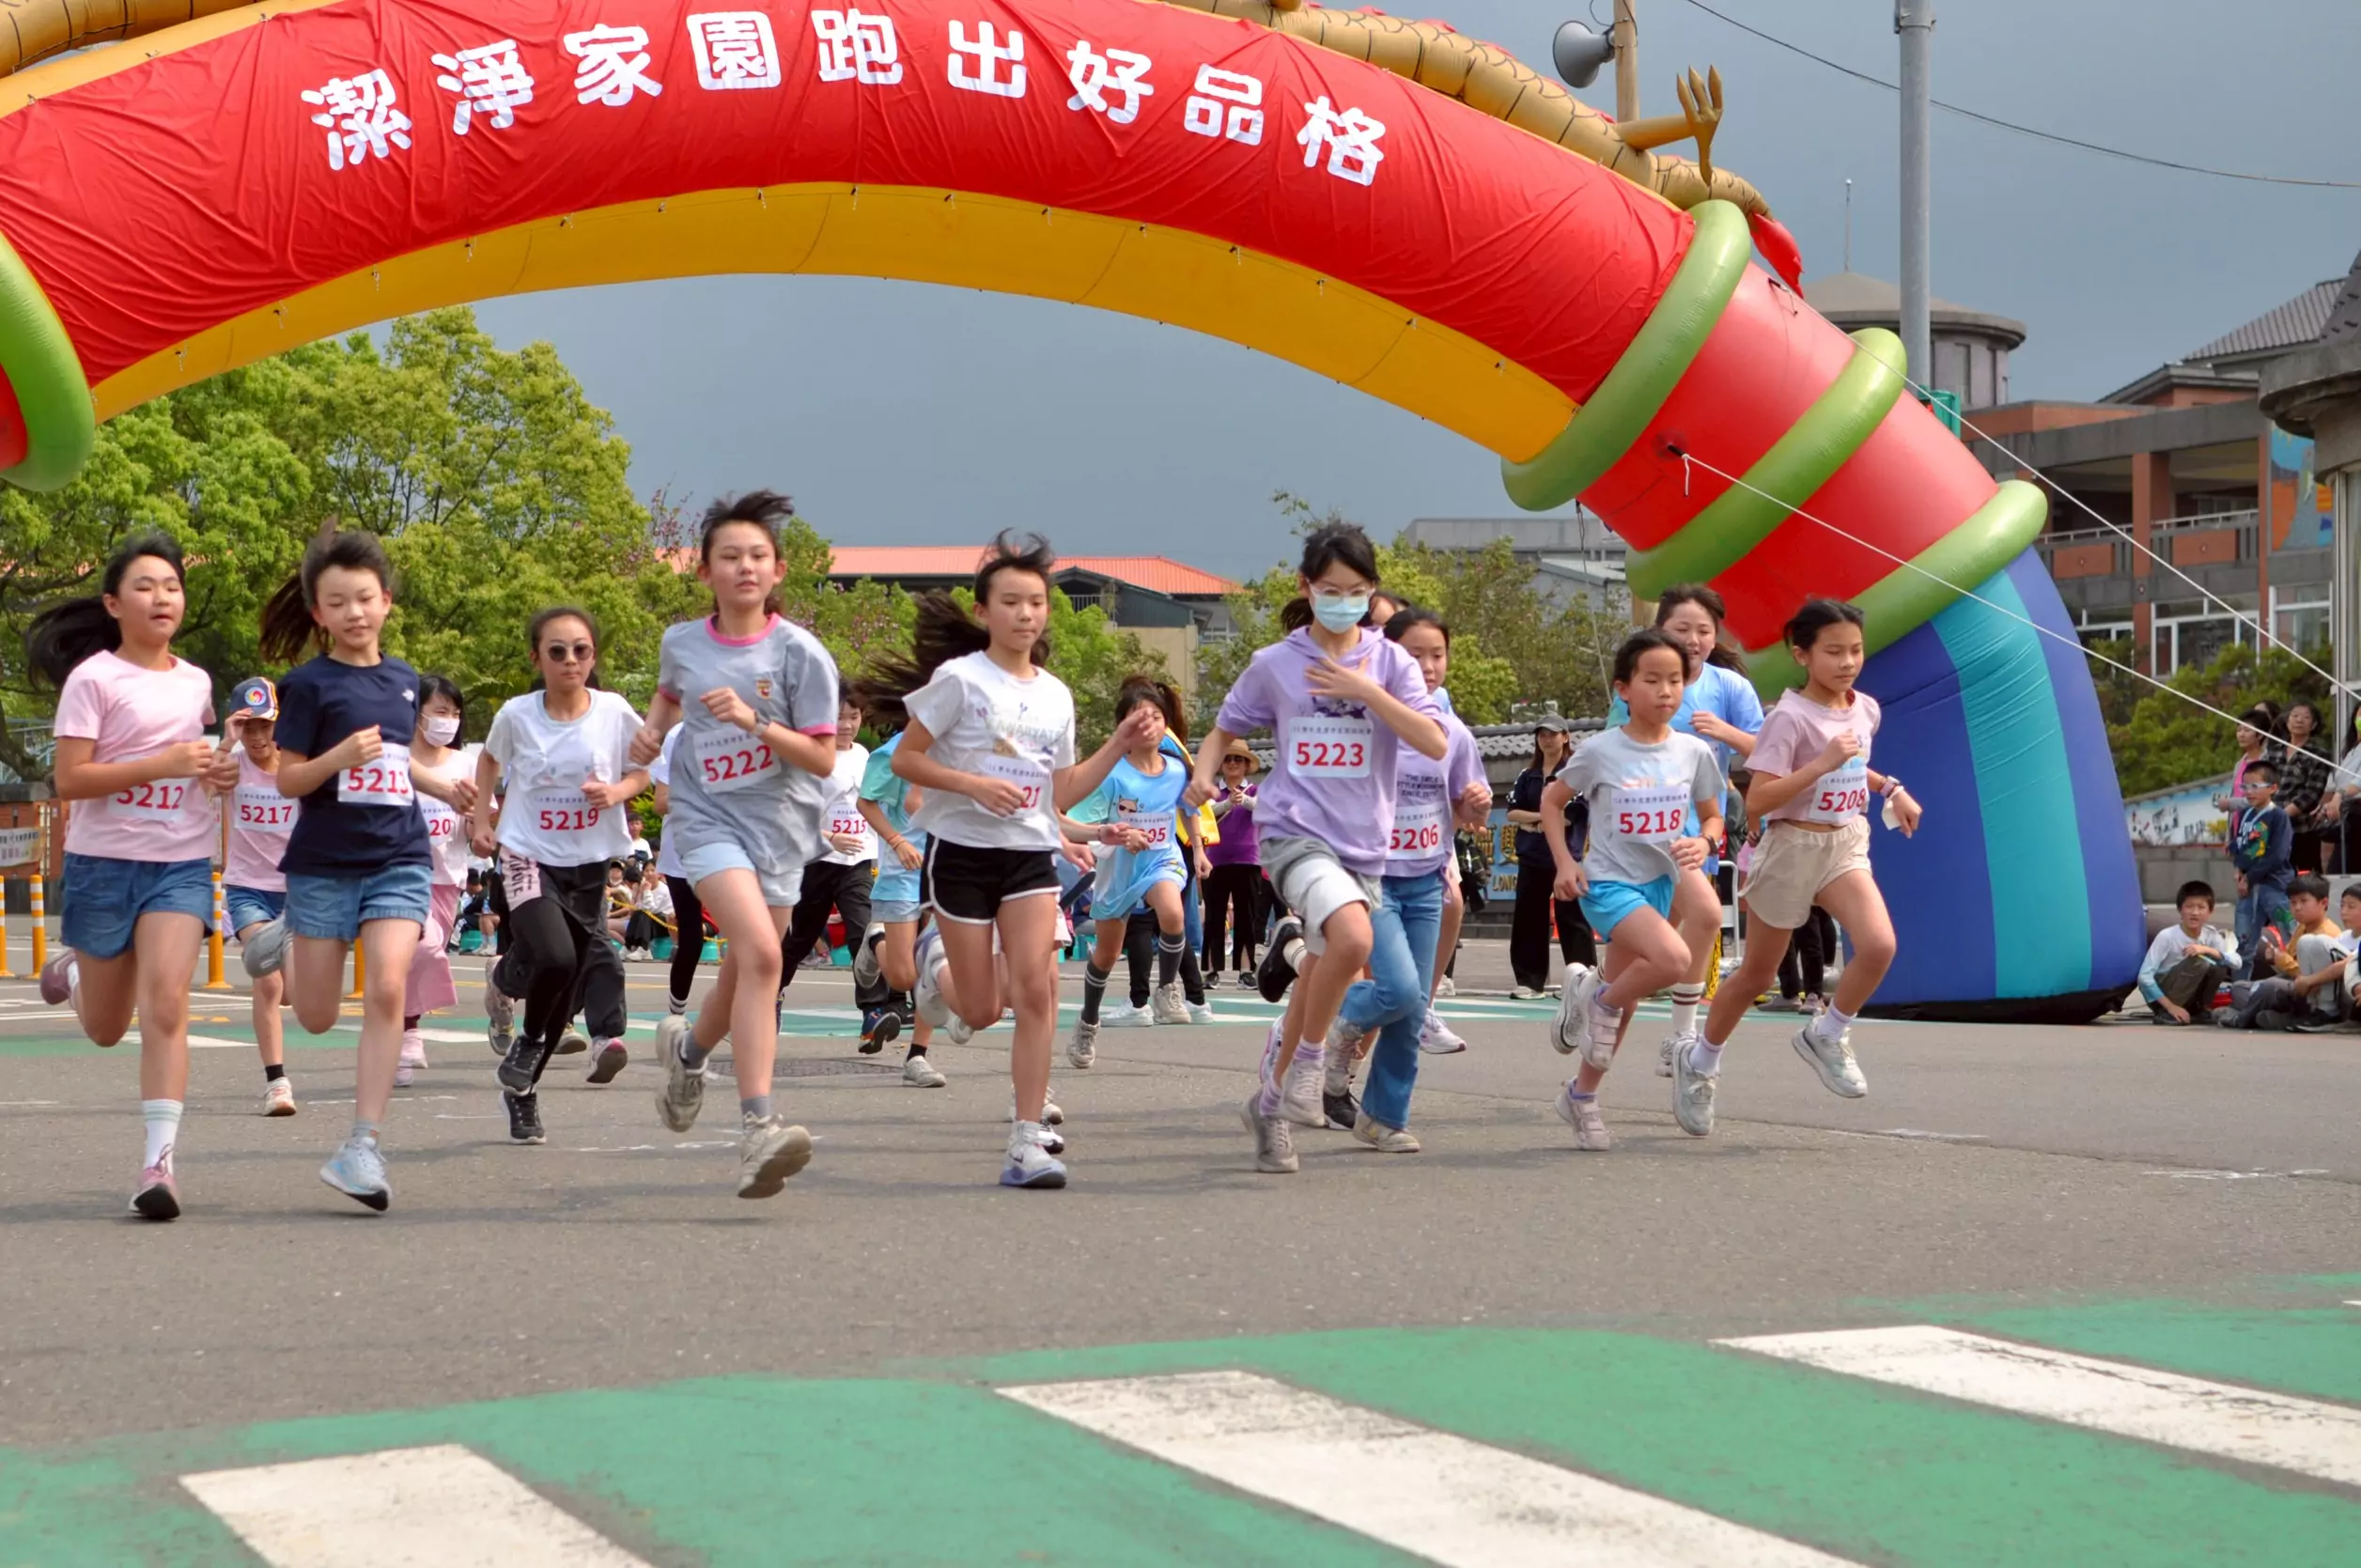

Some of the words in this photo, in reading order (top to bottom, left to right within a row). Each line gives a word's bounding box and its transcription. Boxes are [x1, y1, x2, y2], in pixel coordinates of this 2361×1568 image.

[301, 8, 1386, 186] 潔淨家園跑出好品格
[703, 745, 773, 782] 5222
[1297, 742, 1363, 767] 5223
[1020, 785, 1041, 809] 21
[1818, 787, 1866, 813] 5208
[241, 804, 292, 824] 5217
[539, 807, 599, 831] 5219
[1619, 809, 1681, 834] 5218
[429, 818, 451, 836] 20
[831, 819, 867, 834] 5215
[1140, 828, 1166, 843] 05
[1390, 824, 1438, 850] 5206
